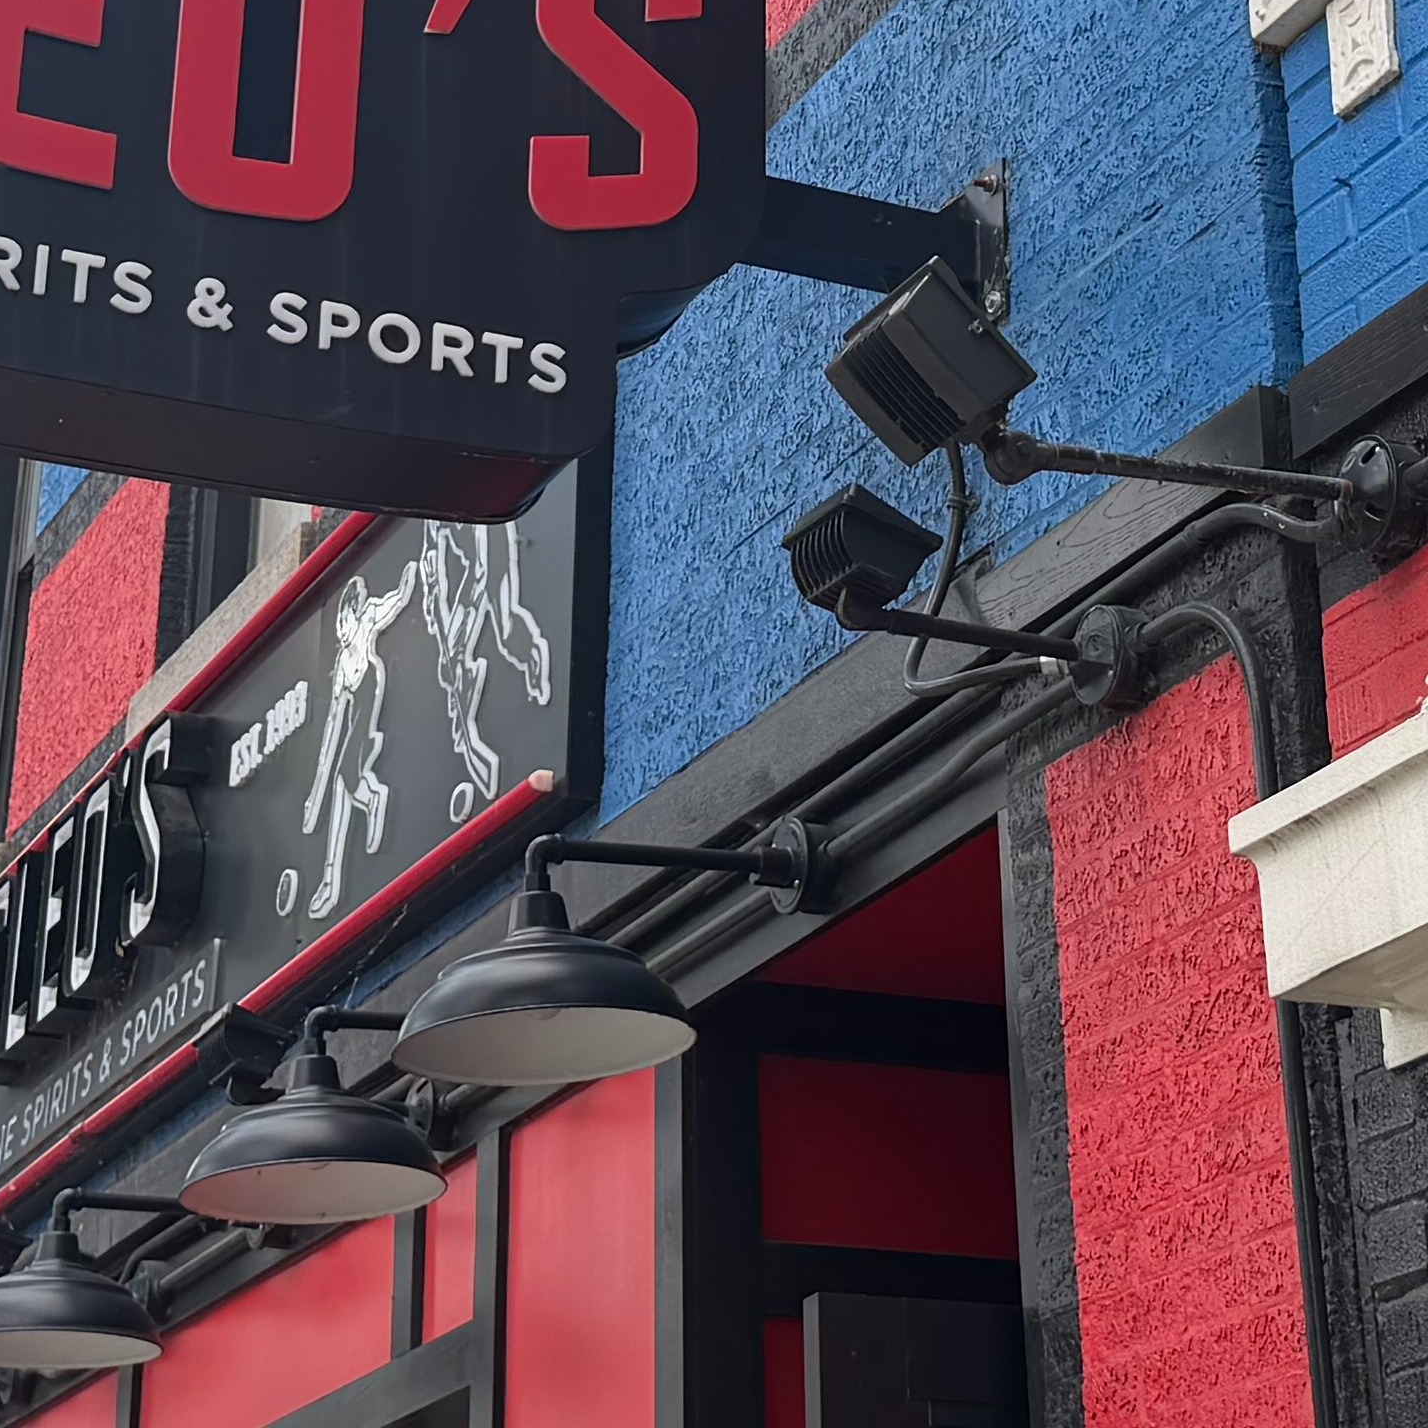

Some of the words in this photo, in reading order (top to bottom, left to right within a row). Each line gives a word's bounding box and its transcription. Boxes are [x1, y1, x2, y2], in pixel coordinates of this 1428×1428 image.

[187, 276, 236, 331] &
[266, 292, 569, 395] SPORTS
[20, 1054, 94, 1148] SPIRITS
[97, 1037, 113, 1079] &
[119, 957, 207, 1067] SPORTS
